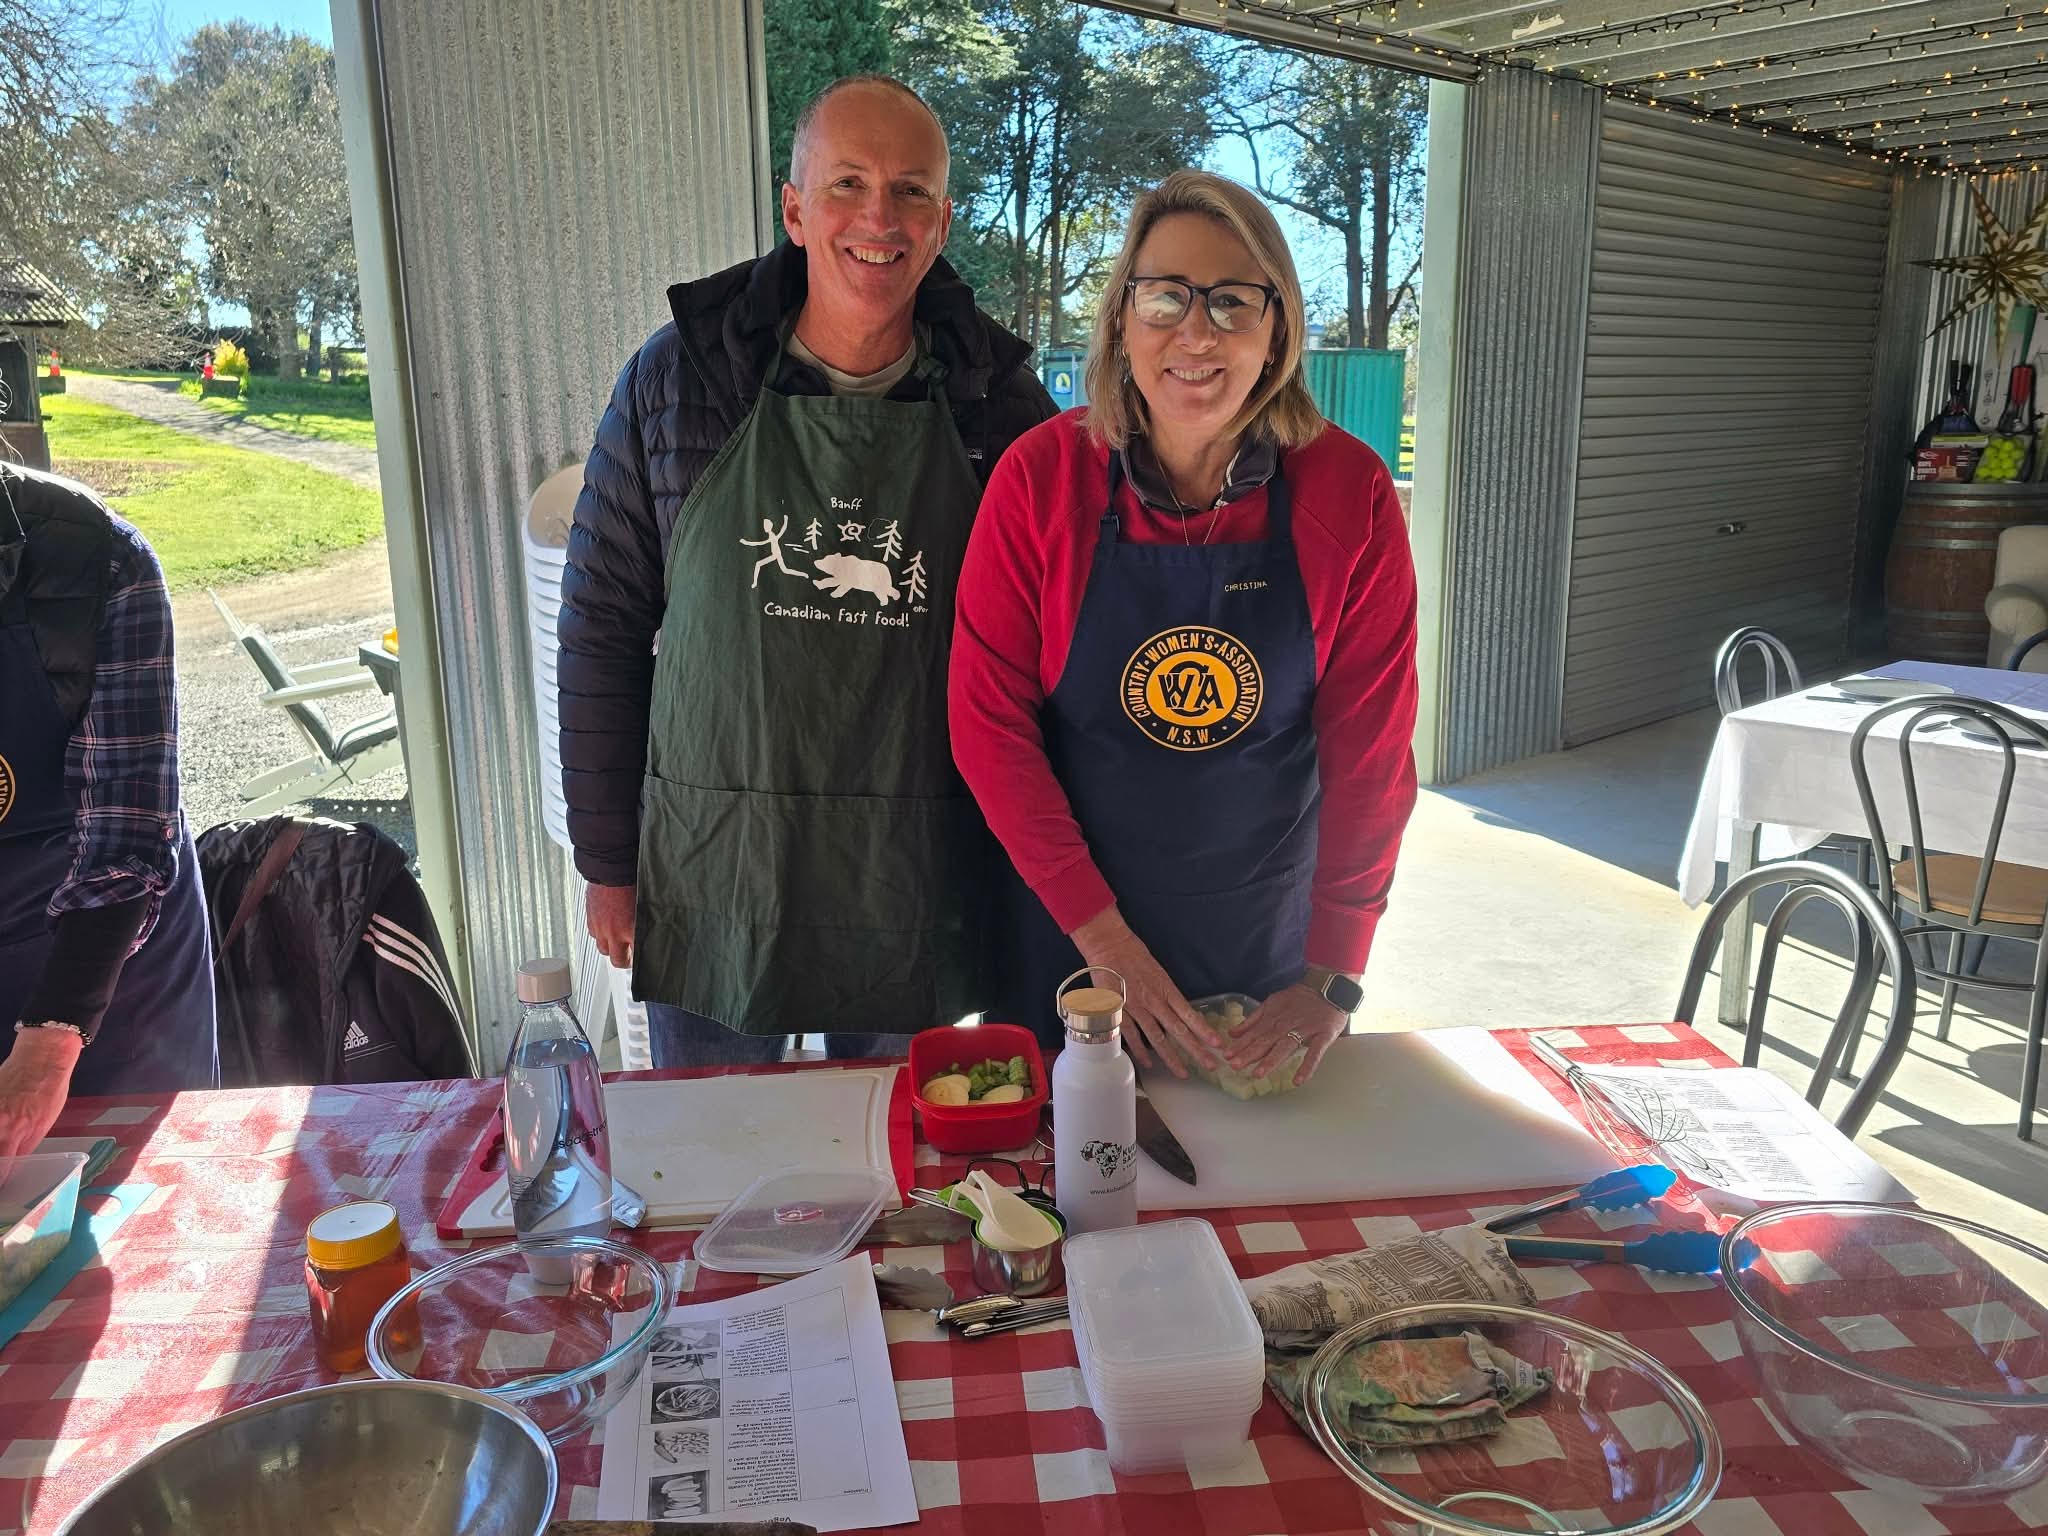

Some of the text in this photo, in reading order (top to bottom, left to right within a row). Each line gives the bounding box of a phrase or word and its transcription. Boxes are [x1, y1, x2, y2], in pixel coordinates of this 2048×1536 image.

[830, 496, 864, 511] Banff
[1224, 580, 1268, 592] CHRISTINA
[763, 602, 831, 621] Canadian
[1127, 632, 1258, 723] COUNTRY WOMEN'S ASSOCIATION
[344, 1035, 369, 1051] didas
